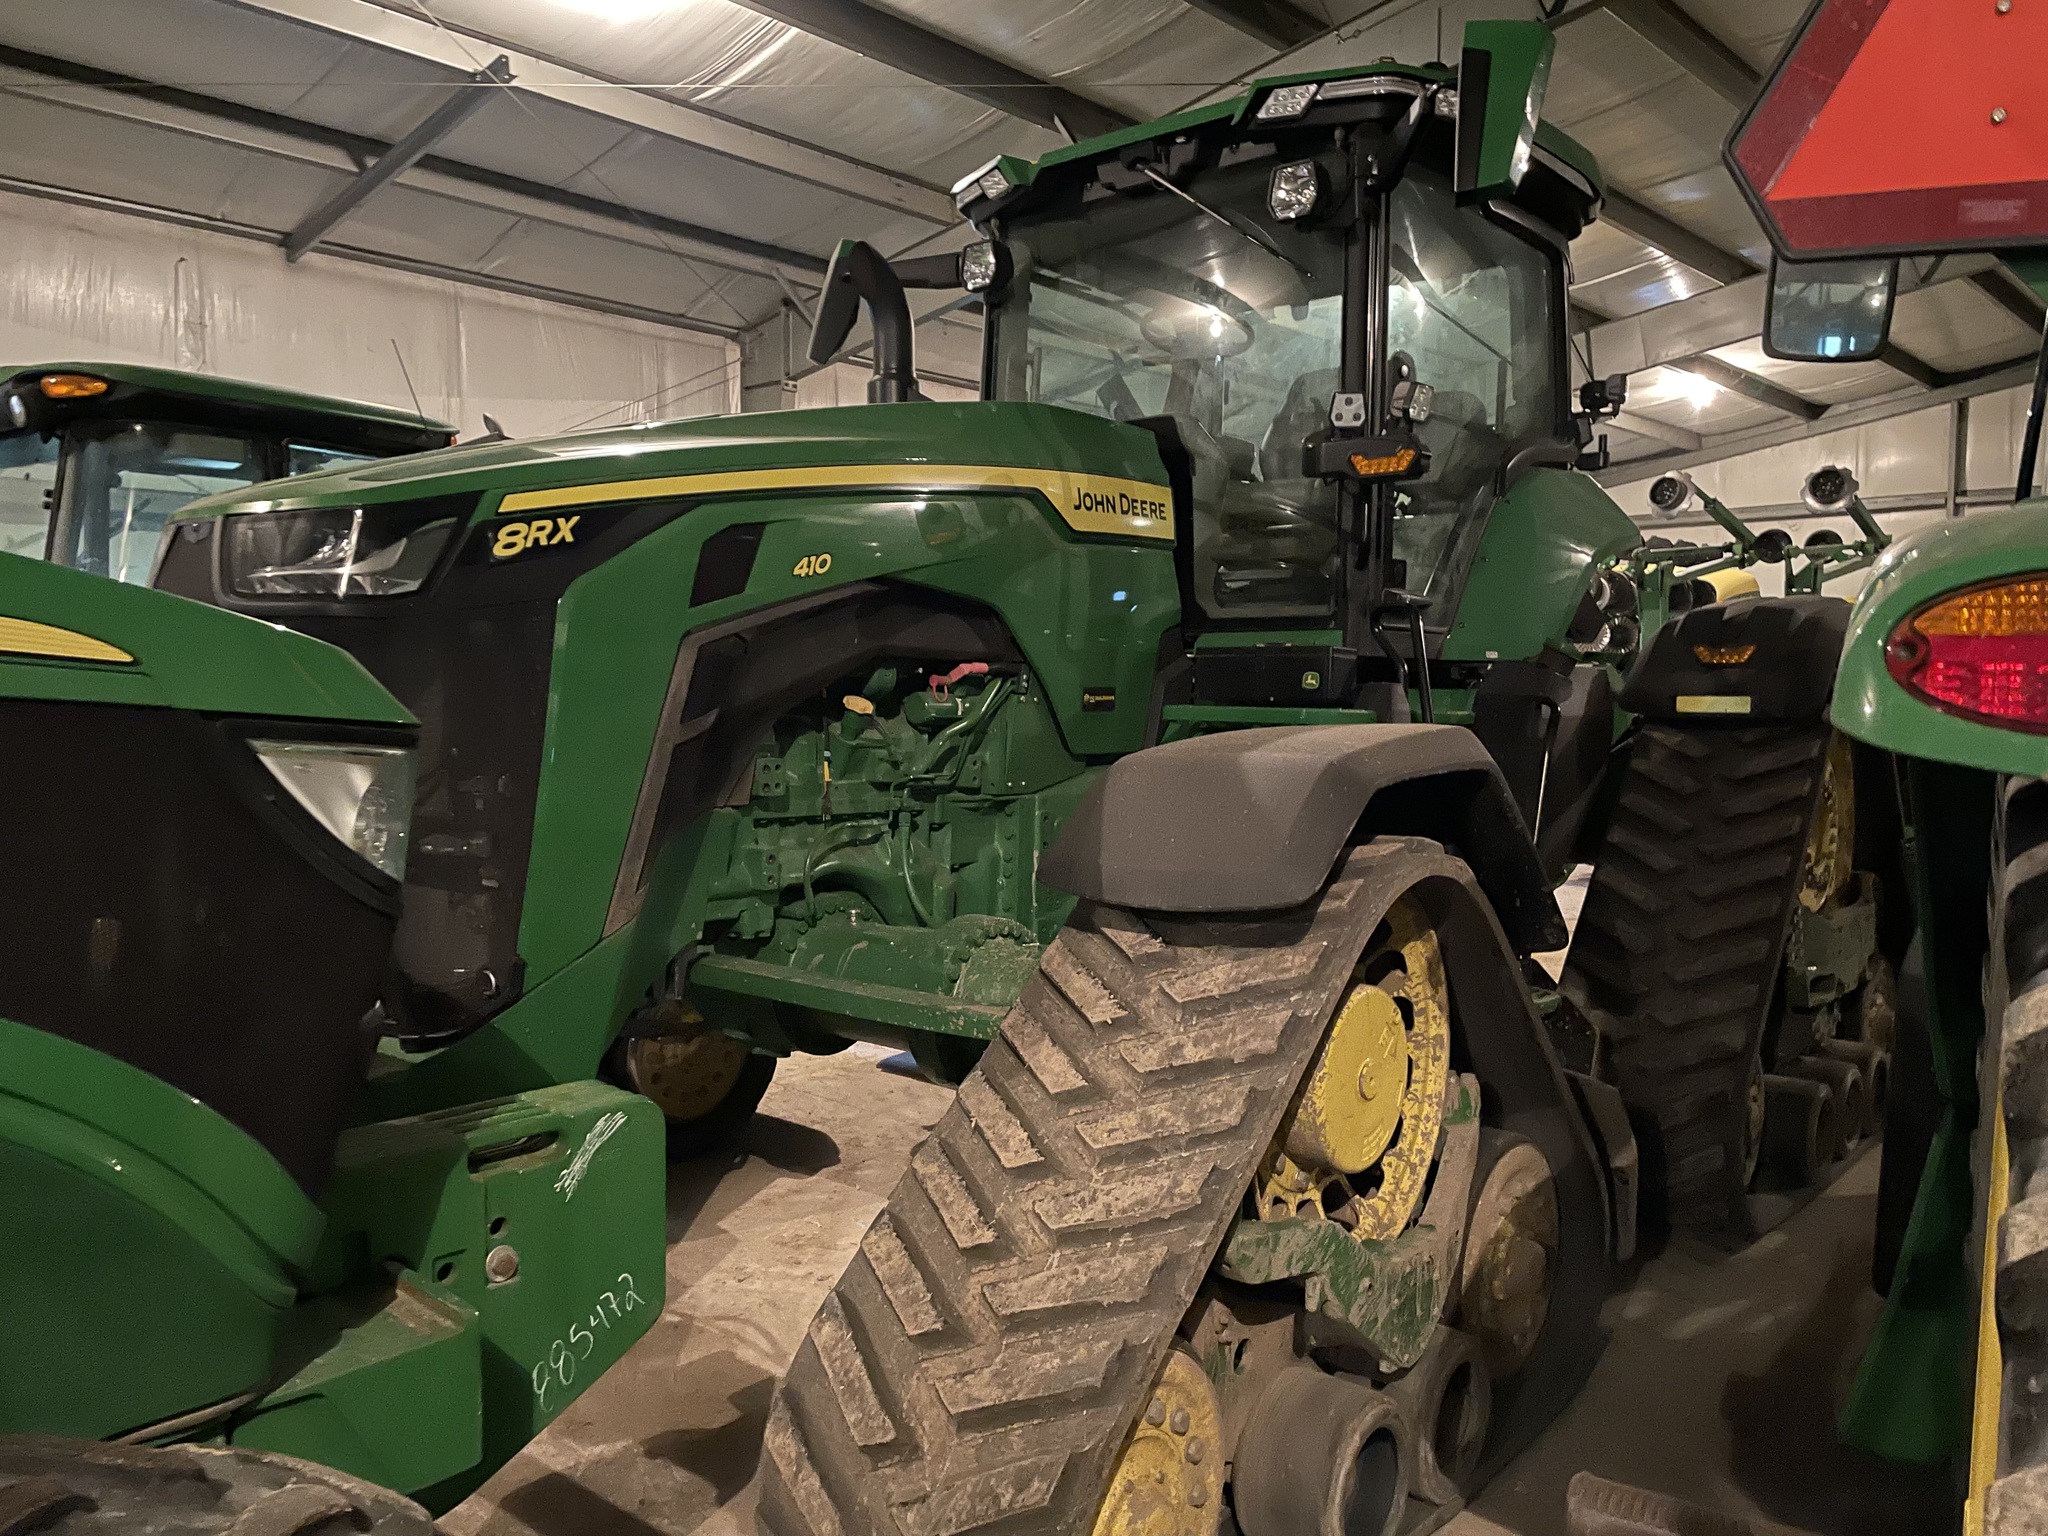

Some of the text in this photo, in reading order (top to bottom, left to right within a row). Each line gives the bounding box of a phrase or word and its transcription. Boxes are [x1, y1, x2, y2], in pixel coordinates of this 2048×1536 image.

[1074, 487, 1167, 520] JOHN DEERE
[492, 515, 581, 557] 8RX
[793, 553, 832, 577] 410
